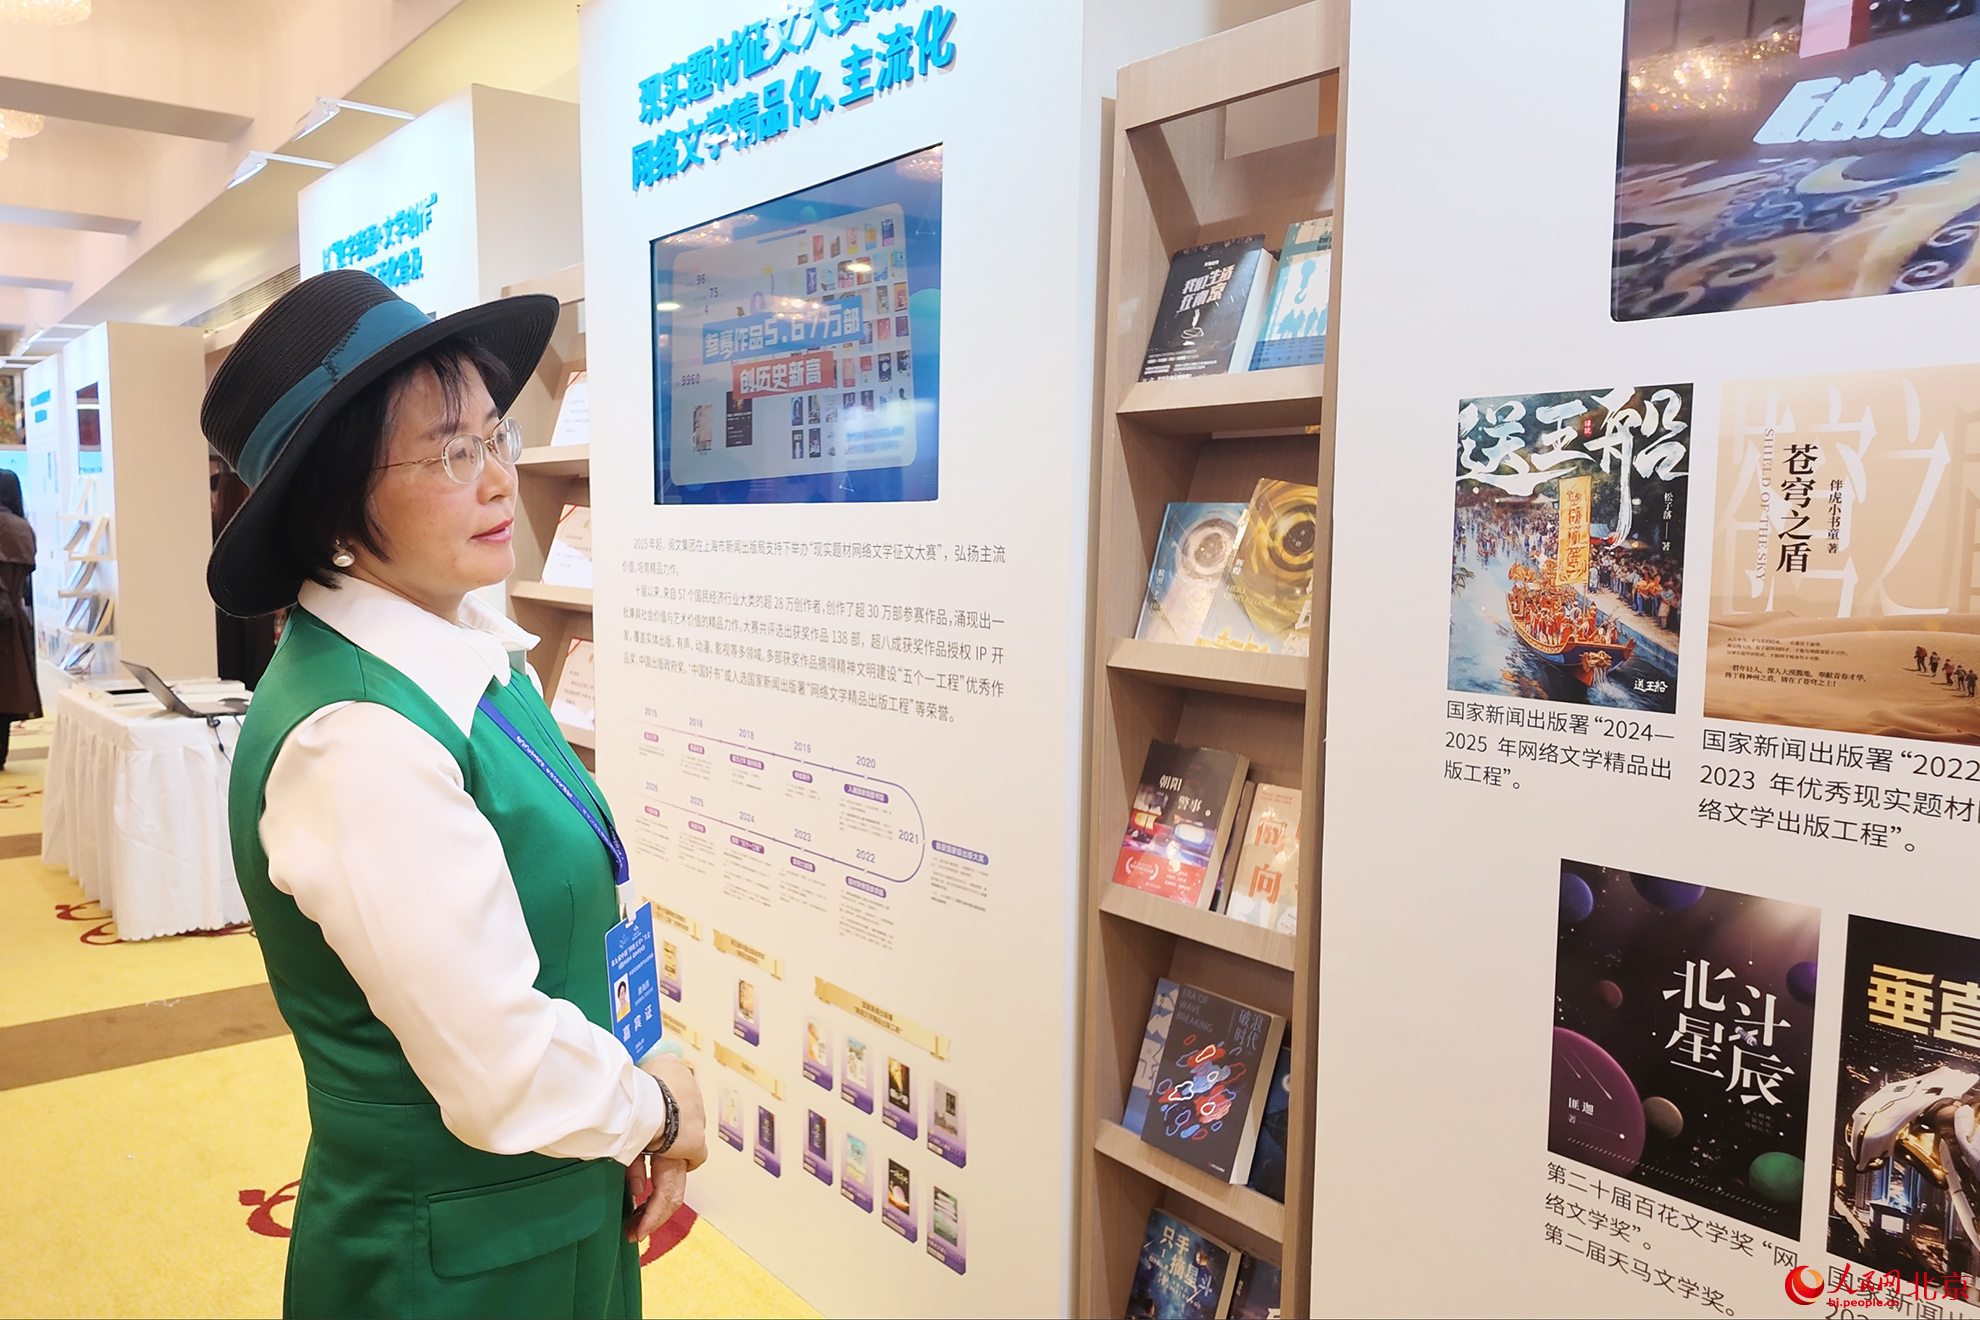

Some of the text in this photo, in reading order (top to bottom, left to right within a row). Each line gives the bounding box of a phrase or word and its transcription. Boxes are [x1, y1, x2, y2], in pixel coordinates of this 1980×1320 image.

[638, 0, 908, 125] 现实题材征文大赛
[632, 4, 956, 191] 网络文学精品化、主流化
[1176, 282, 1227, 314] 在南京
[1182, 264, 1235, 295] 我们生活
[739, 357, 822, 394] 创历史新高
[1456, 386, 1689, 550] 送王船
[1762, 428, 1774, 488] SHIELD
[1776, 444, 1819, 573] 苍穹之盾
[1826, 479, 1843, 541] 伴虎小书童
[1756, 552, 1767, 582] SKY
[1633, 677, 1669, 694] 送王船
[689, 717, 703, 728] 2016
[739, 728, 755, 740] 2018
[793, 741, 811, 754] 2019
[856, 755, 876, 769] 2020
[1444, 731, 1673, 780] 2025 年网络文学精品出
[1159, 773, 1183, 791] 朝阳
[1443, 758, 1521, 791] 版工程”。
[1699, 764, 1980, 824] 2023 年优秀现实题材
[794, 828, 812, 842] 2023
[898, 829, 919, 845] 2021
[1698, 796, 1917, 854] 络文学出版工程”。
[856, 848, 876, 863] 2022
[1176, 1010, 1214, 1033] BREAKING
[1662, 959, 1792, 1048] 北斗
[1664, 1012, 1795, 1107] 星辰
[1544, 1192, 1653, 1251] 络文学奖”。
[1547, 1161, 1799, 1270] 第二十届百花文学奖“网
[1544, 1221, 1736, 1319] 第二届天马文学奖。
